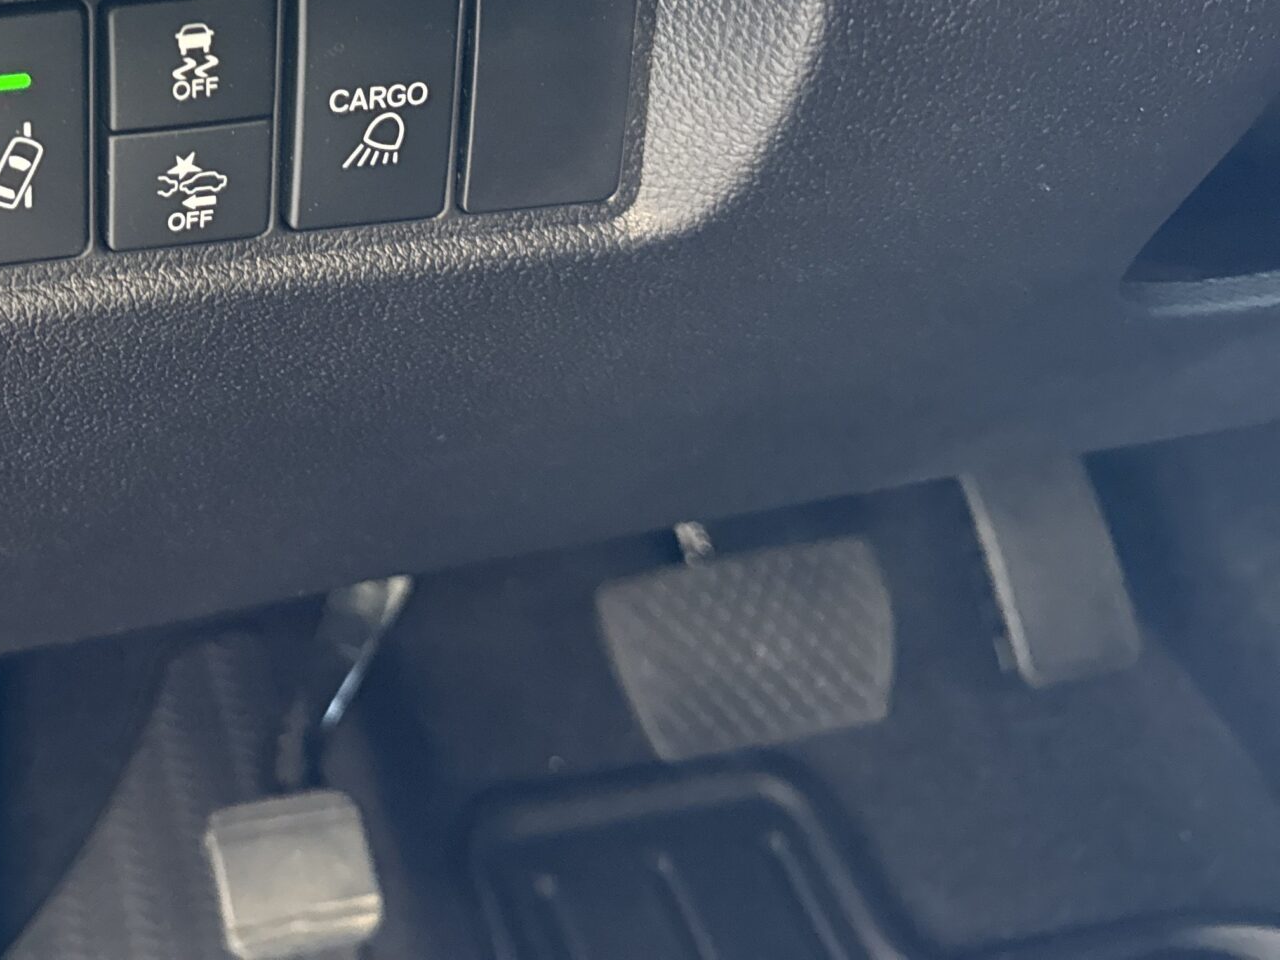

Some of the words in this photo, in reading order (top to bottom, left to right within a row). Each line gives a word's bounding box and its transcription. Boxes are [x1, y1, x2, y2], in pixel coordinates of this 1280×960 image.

[172, 77, 219, 101] OFF
[328, 81, 428, 113] CARGO
[167, 209, 214, 232] OFF
